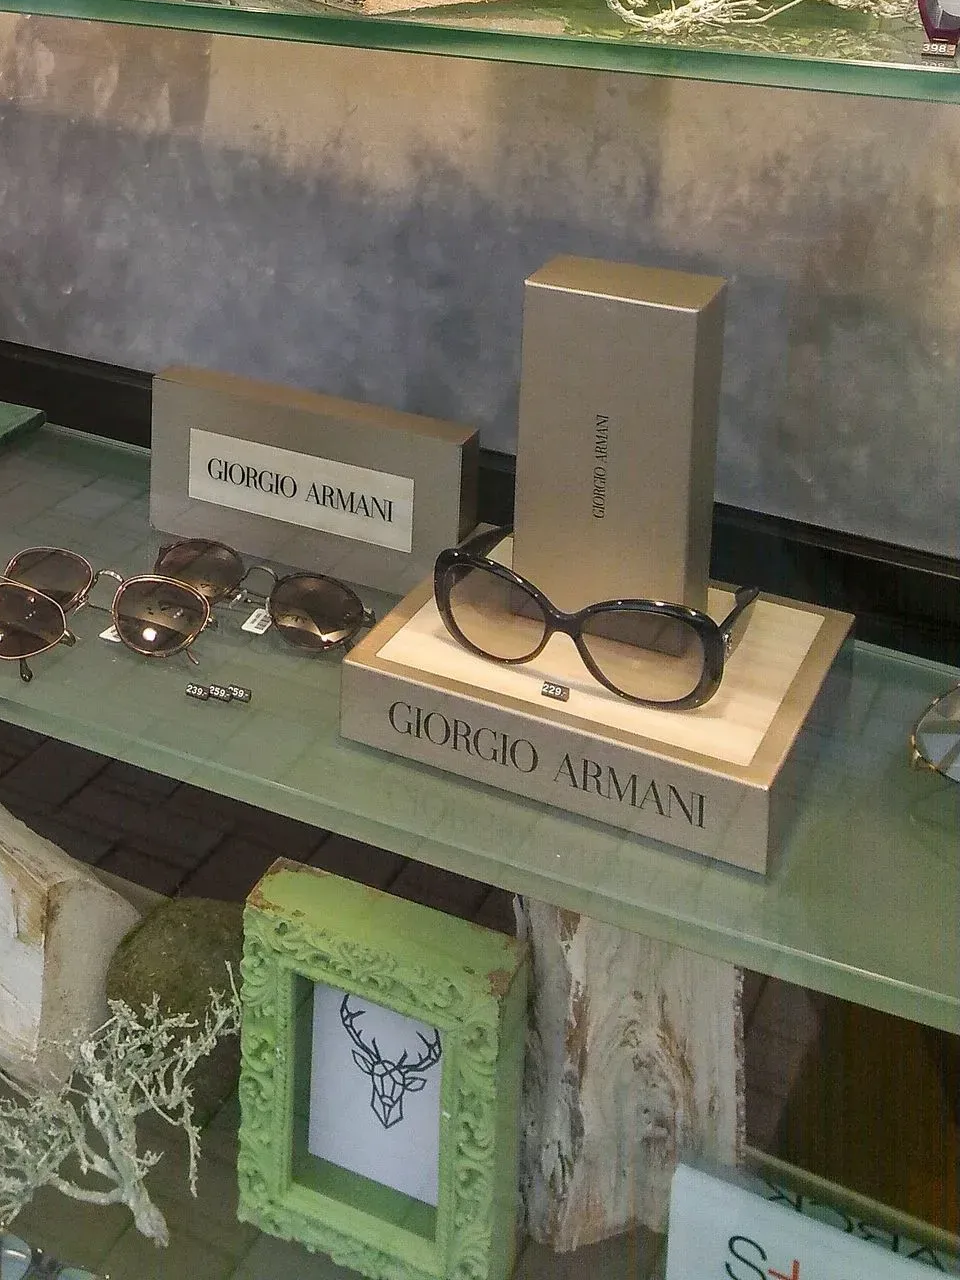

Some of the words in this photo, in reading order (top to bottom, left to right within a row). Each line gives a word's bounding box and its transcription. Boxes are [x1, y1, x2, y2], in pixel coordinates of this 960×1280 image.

[595, 414, 609, 463] ARMANI
[207, 457, 298, 499] GIORGIO
[305, 482, 394, 523] ARMANI
[592, 466, 606, 519] GIORGIO
[388, 701, 539, 773] GIORGIO
[553, 752, 707, 829] ARMANI
